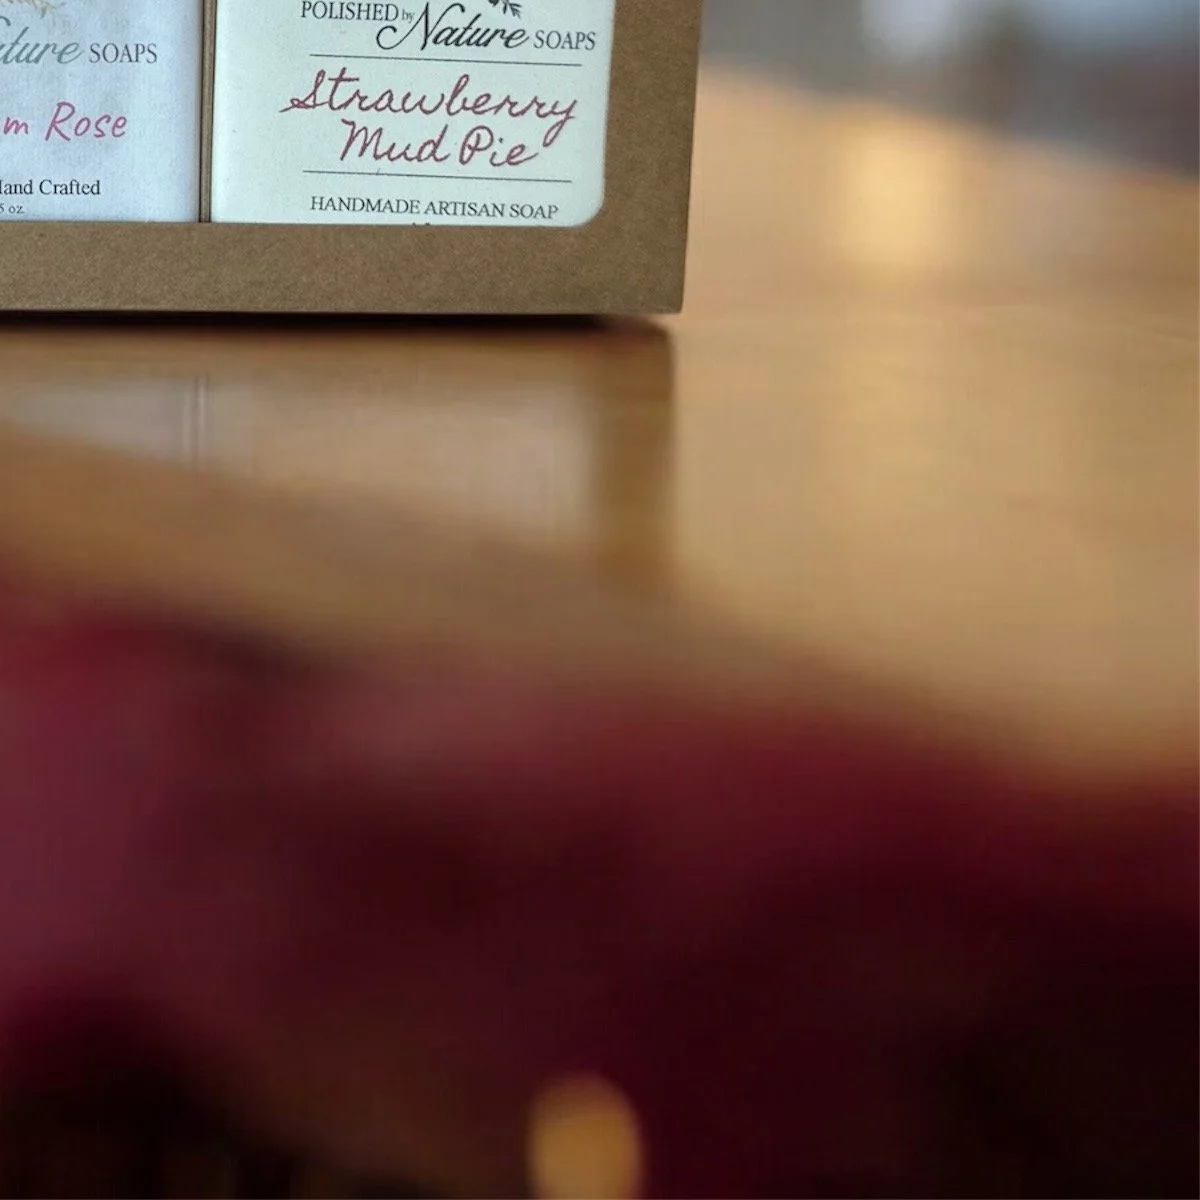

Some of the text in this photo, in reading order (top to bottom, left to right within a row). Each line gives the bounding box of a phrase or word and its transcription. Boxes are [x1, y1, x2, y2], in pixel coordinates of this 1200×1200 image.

[301, 0, 597, 52] POLISHED by Nature SOAPS
[88, 42, 158, 65] SOAPS
[44, 101, 129, 142] Rose
[279, 67, 579, 148] Strawberry
[339, 118, 540, 168] Mud Pie
[39, 179, 101, 196] Crafted
[309, 196, 559, 220] HANDMADE ARTISAN SOAP
